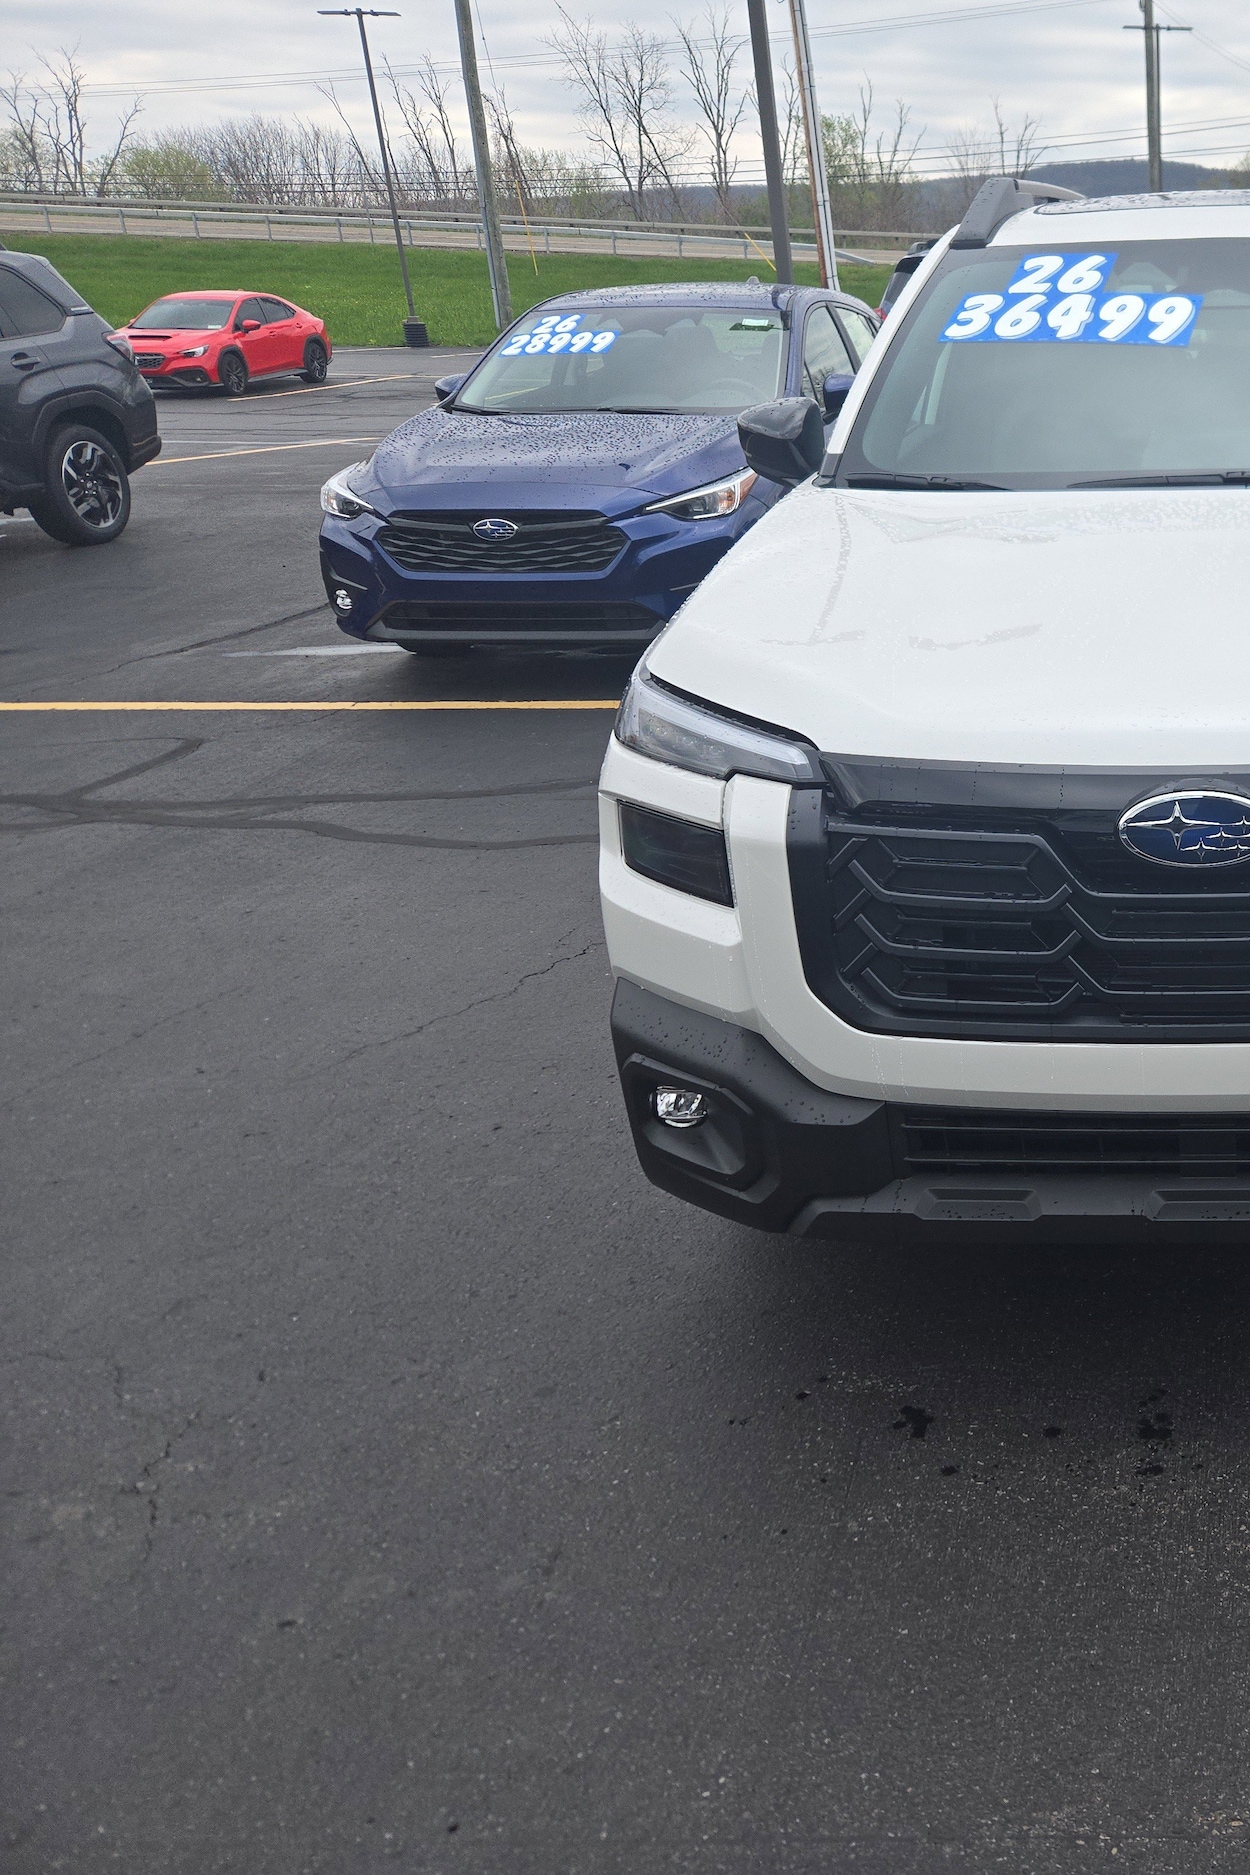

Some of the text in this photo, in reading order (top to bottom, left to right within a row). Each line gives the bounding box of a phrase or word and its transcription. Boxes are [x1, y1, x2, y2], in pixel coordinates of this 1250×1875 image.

[1008, 254, 1107, 294] 26
[532, 314, 582, 334] 26
[944, 293, 1196, 344] 36499
[500, 331, 616, 356] 28999
